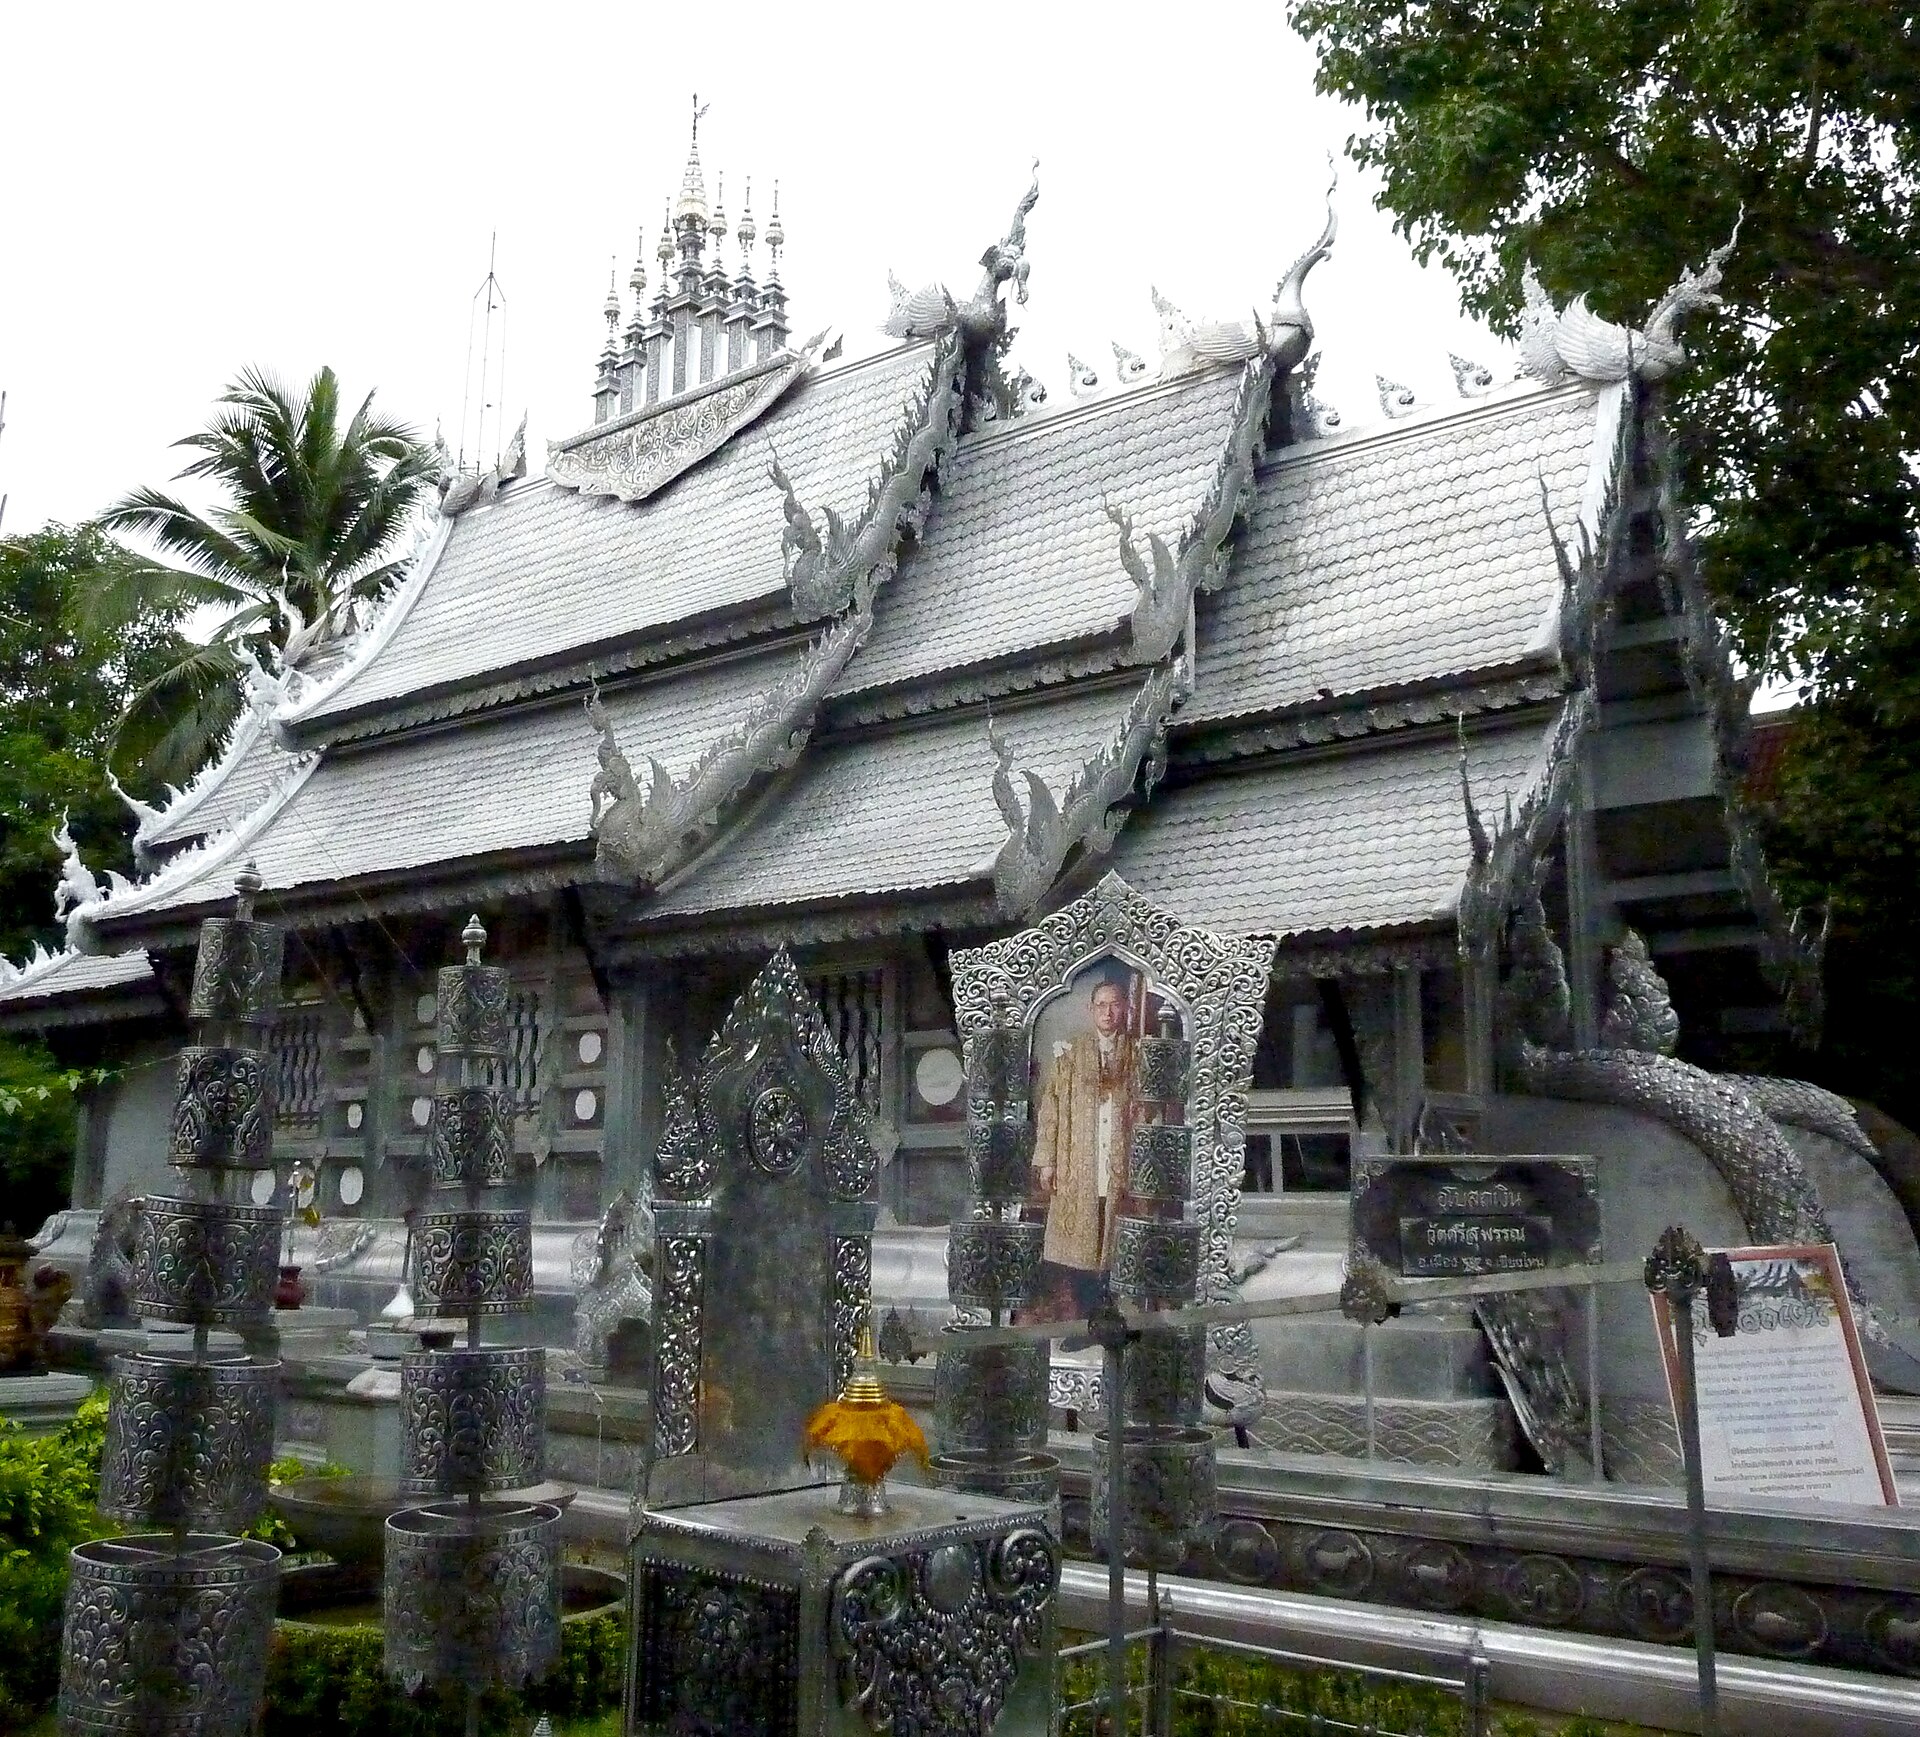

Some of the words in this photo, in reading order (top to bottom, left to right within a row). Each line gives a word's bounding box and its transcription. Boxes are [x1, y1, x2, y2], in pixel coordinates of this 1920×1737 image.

[1438, 1183, 1522, 1211] อุโบสถเงิน
[1426, 1221, 1526, 1251] วัดศรีสุพรรณ
